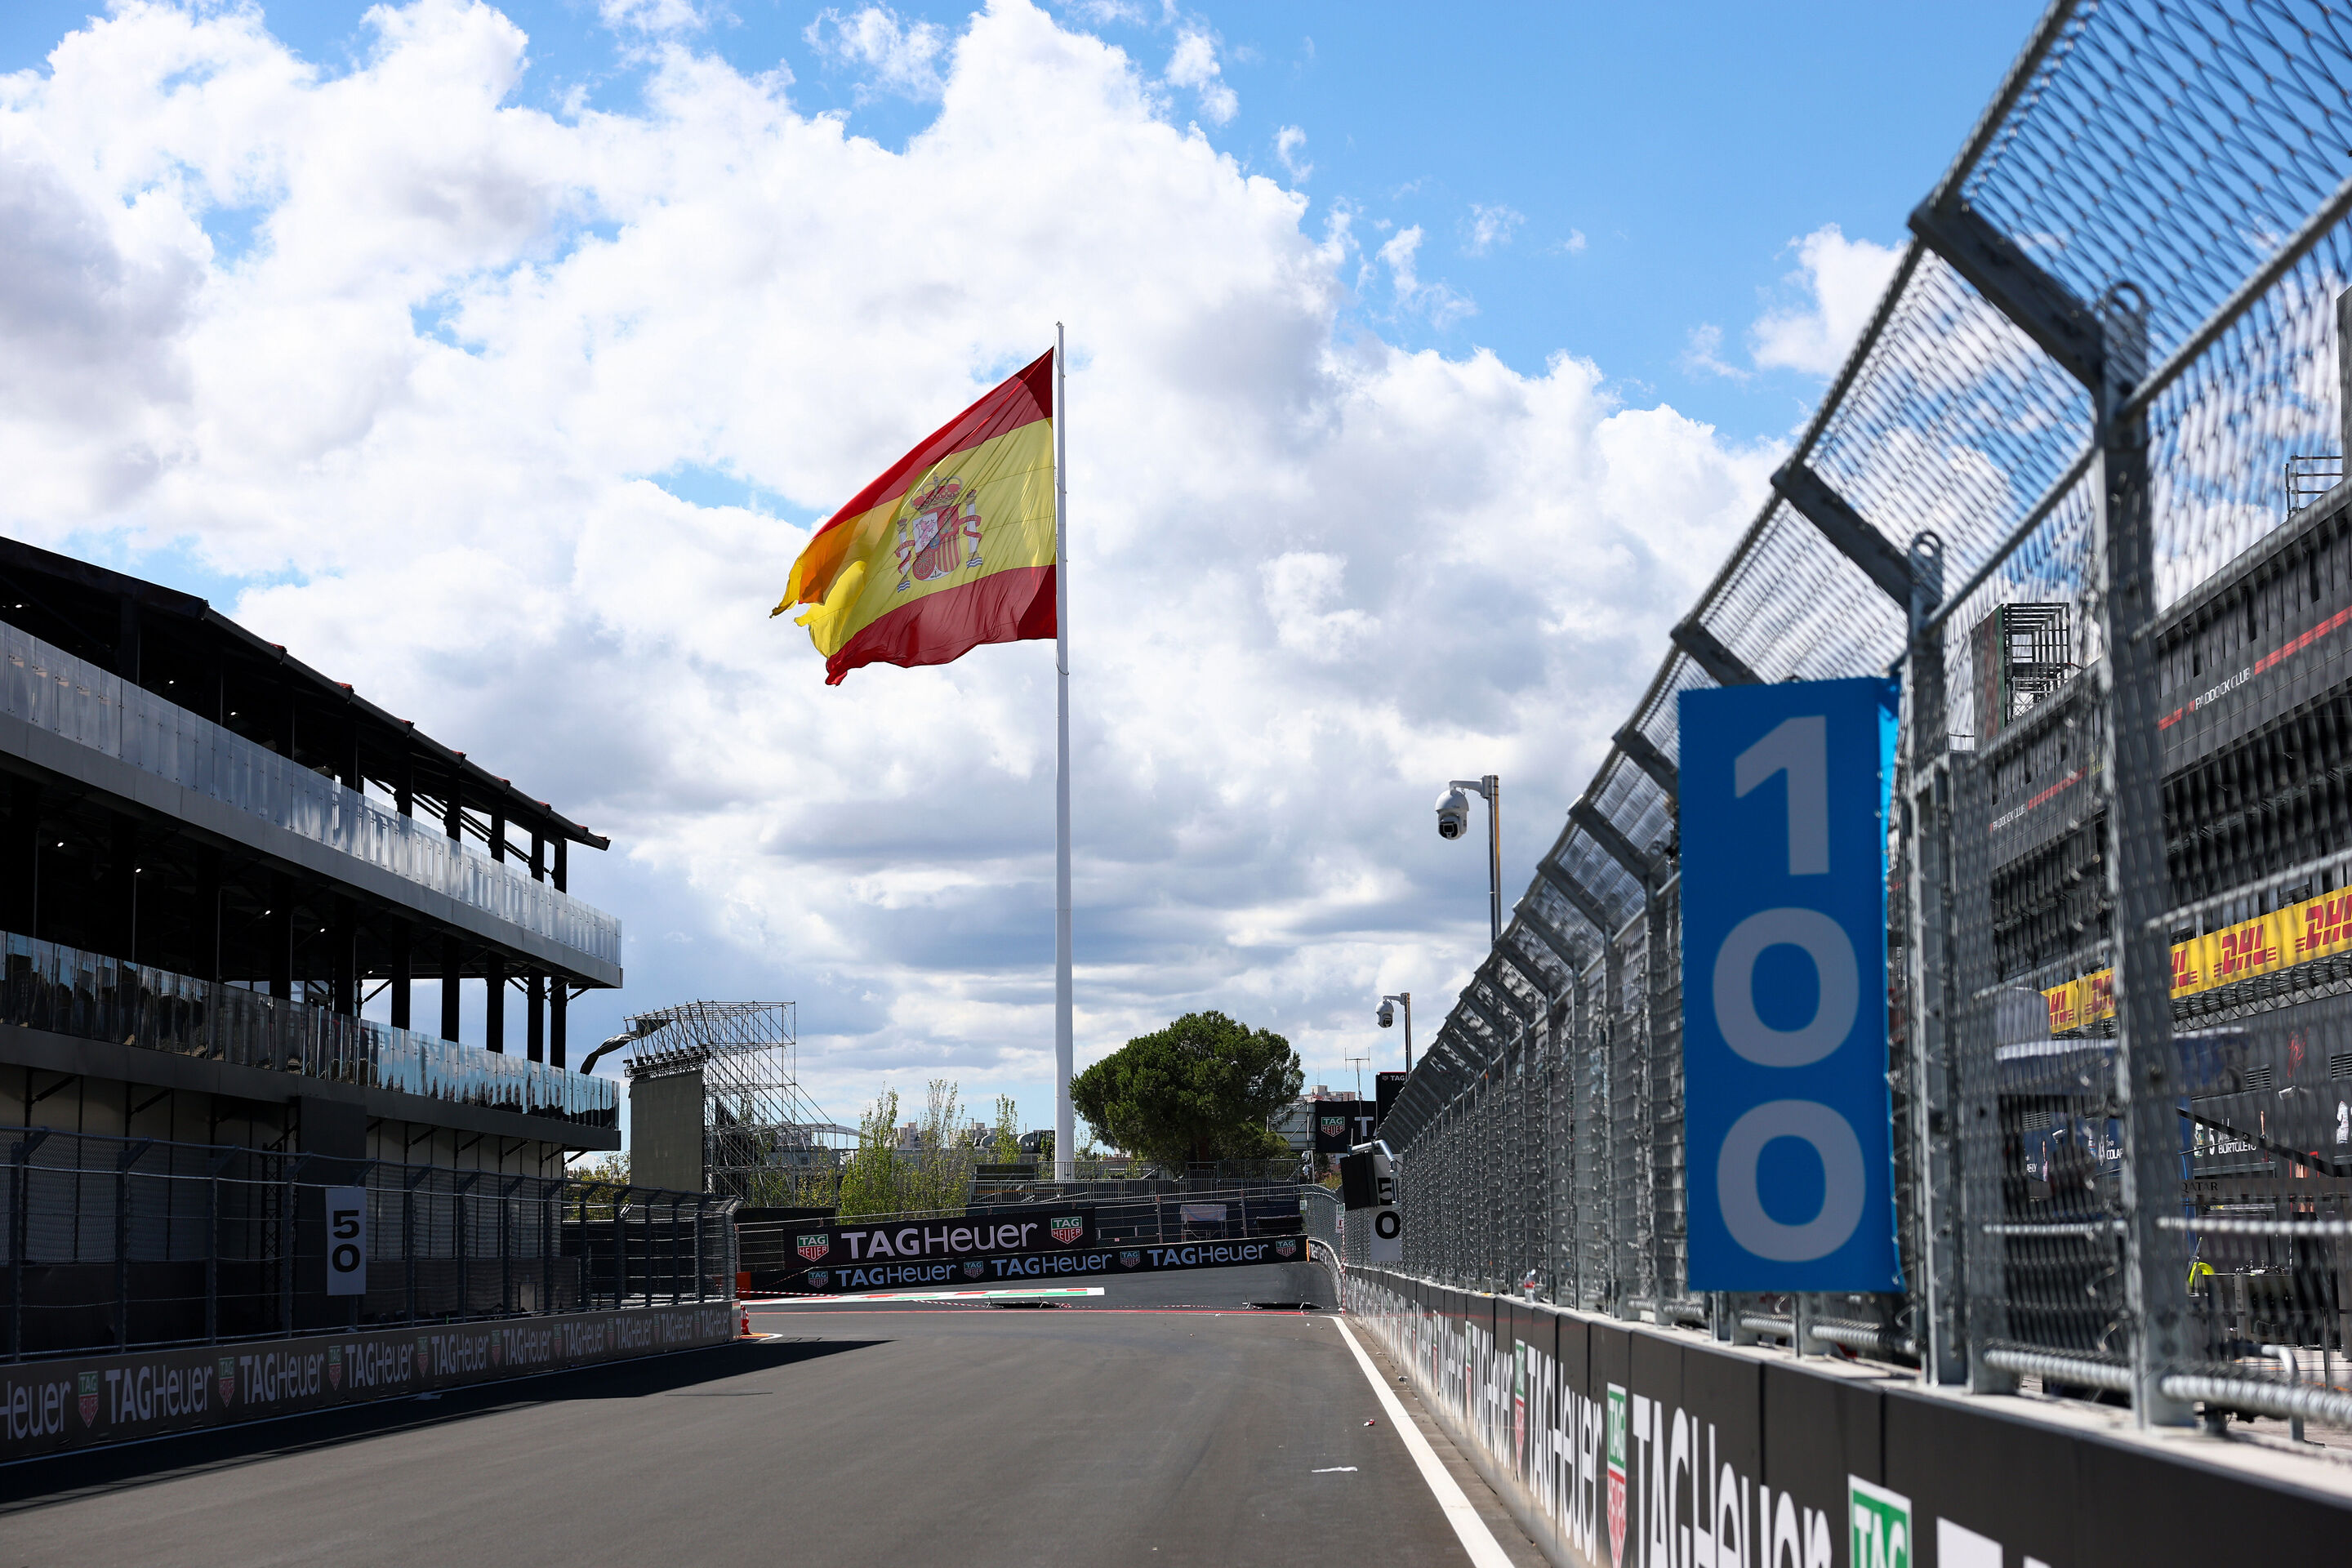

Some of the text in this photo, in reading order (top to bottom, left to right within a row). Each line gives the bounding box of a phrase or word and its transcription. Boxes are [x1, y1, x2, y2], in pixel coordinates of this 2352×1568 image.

[2195, 667, 2252, 710] PADDOCK CLUB
[2221, 924, 2268, 975] DHL
[1713, 715, 1866, 1263] 100
[2046, 991, 2069, 1026] HL
[1323, 1125, 1343, 1136] HEUER
[2181, 1182, 2218, 1193] QATAR
[1054, 1218, 1080, 1228] TAG
[332, 1209, 361, 1273] 50
[800, 1236, 826, 1245] TAG
[1053, 1228, 1081, 1243] HEUER
[800, 1245, 827, 1259] HEUER
[1276, 1247, 1296, 1257] HEUER
[1121, 1258, 1140, 1267] HEUER
[964, 1267, 983, 1277] HEUER
[810, 1278, 827, 1288] HEUER
[220, 1360, 234, 1378] TAG
[81, 1373, 97, 1393] TAG
[1609, 1396, 1625, 1463] TAG
